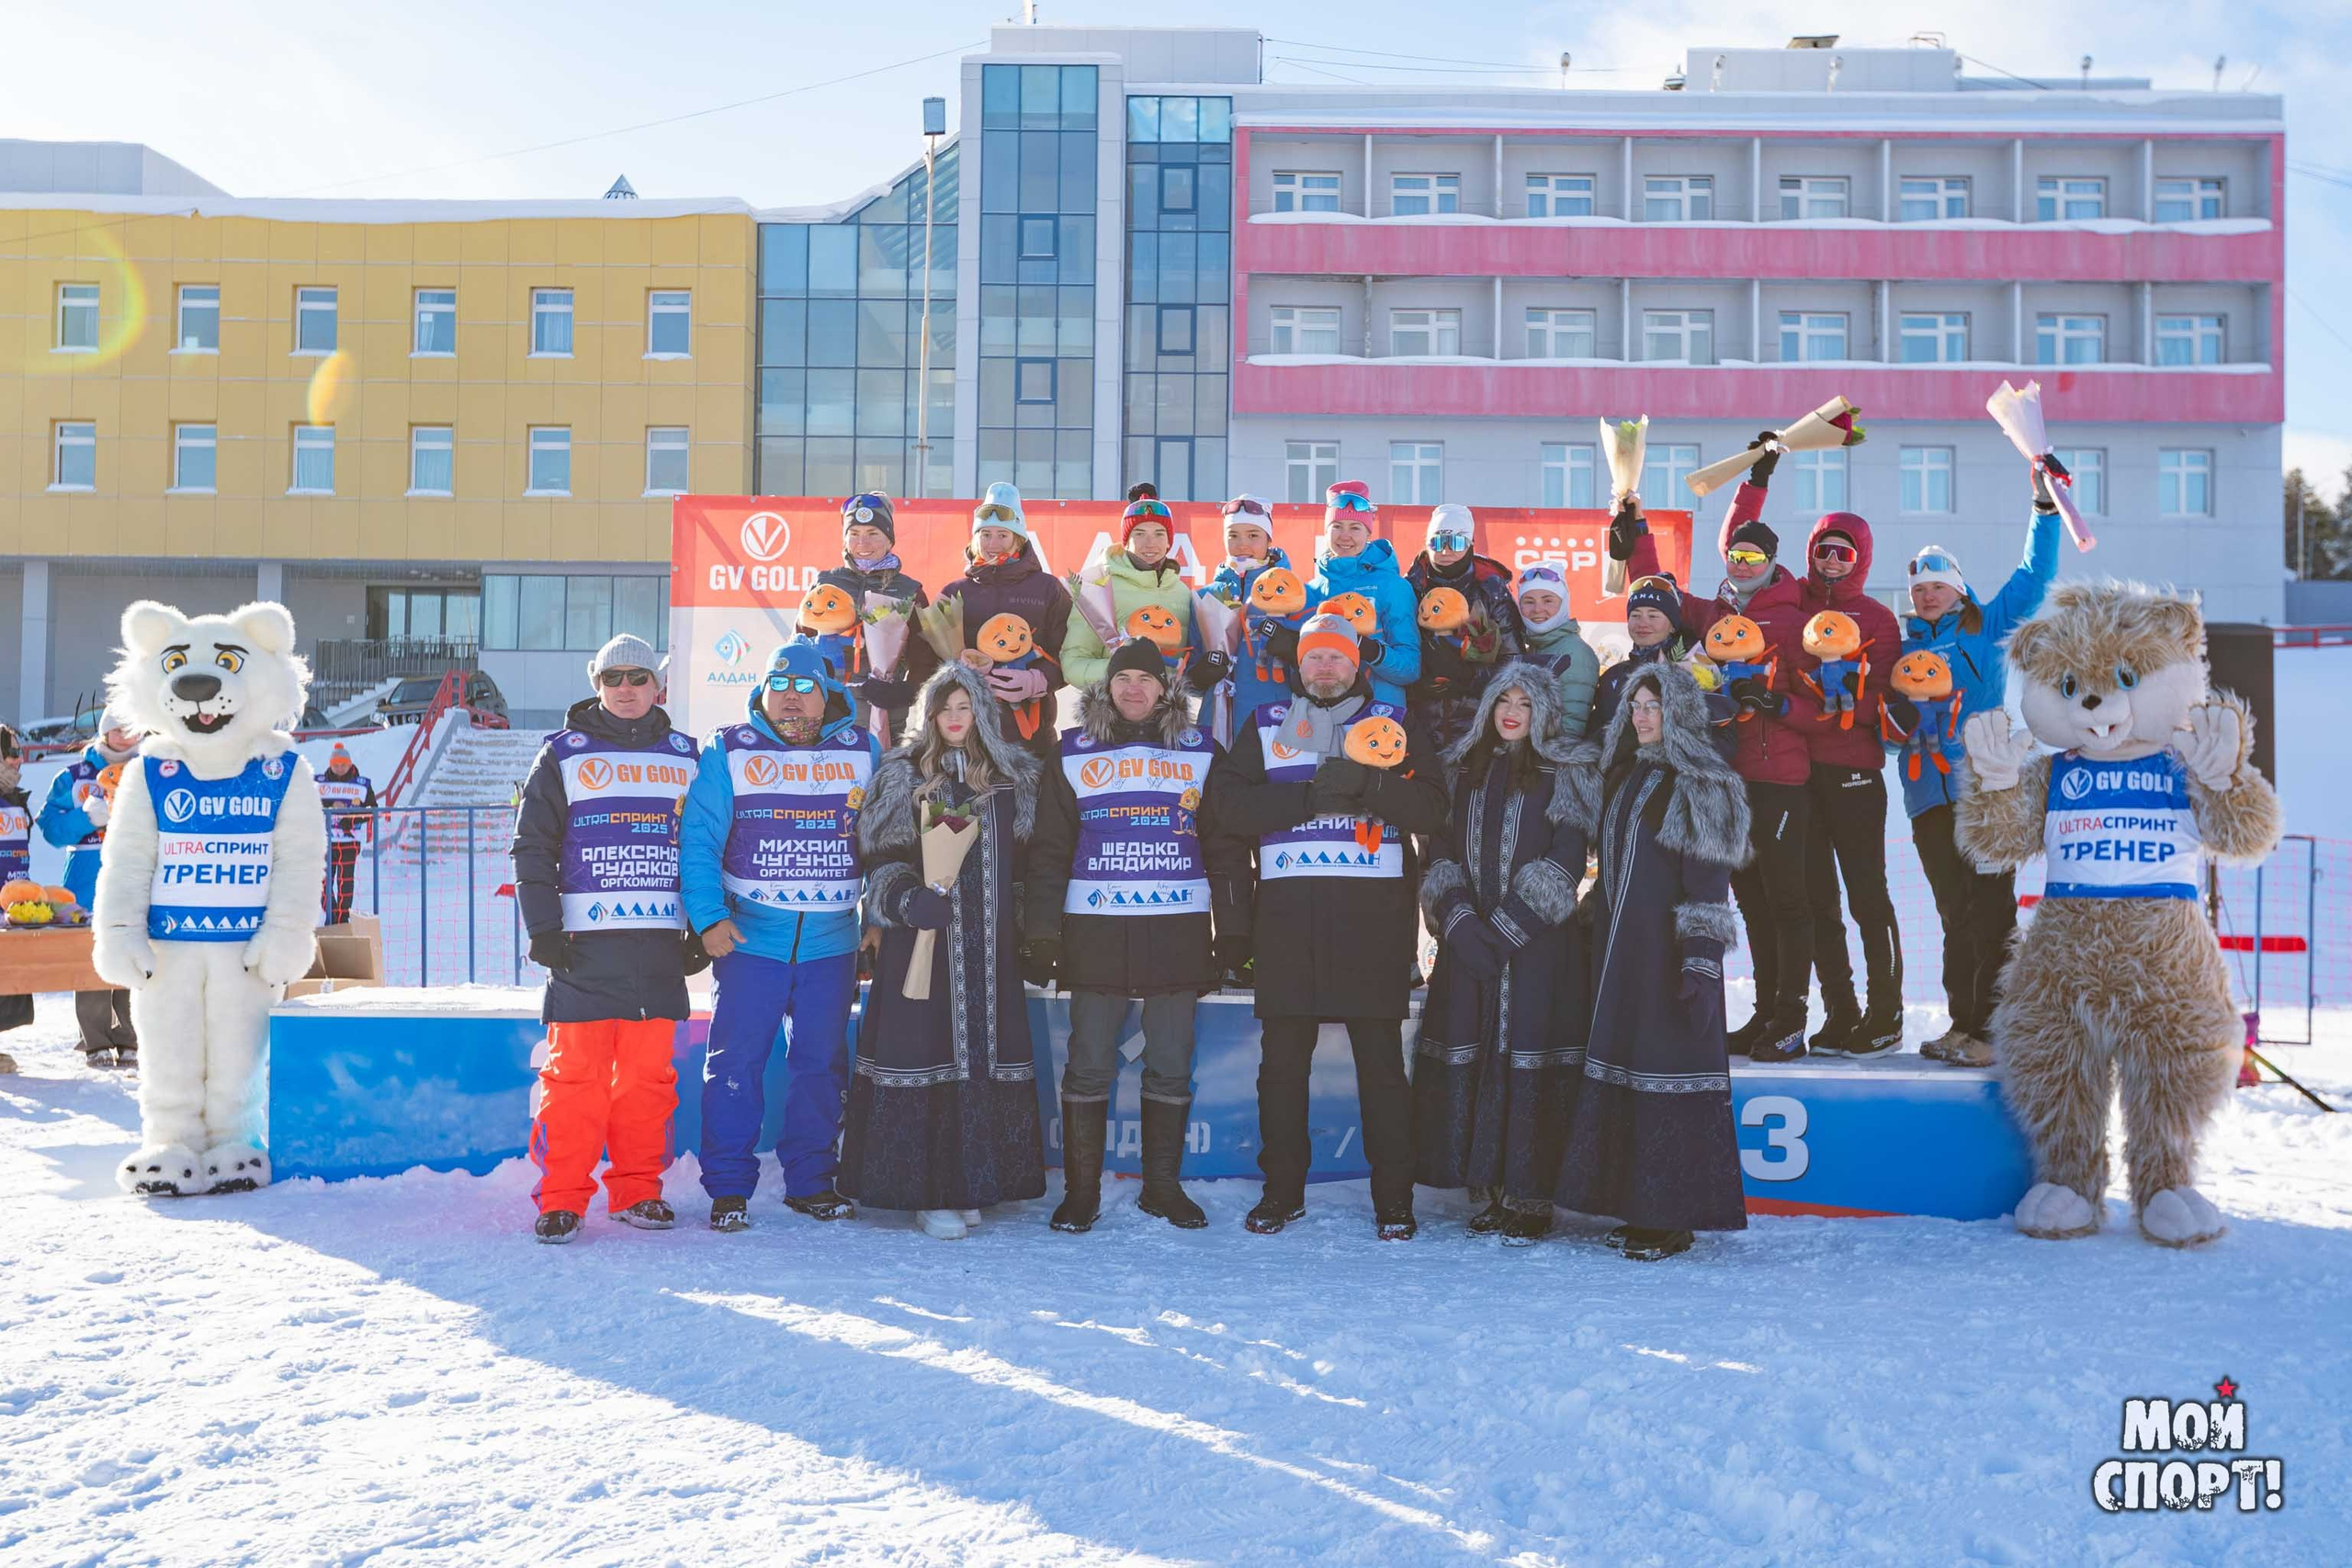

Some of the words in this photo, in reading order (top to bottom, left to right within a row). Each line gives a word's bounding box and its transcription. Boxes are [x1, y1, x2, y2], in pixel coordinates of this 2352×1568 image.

[708, 564, 745, 591] GV
[751, 565, 819, 592] GOLD
[707, 672, 756, 683] АЛДАН
[617, 764, 641, 783] GV
[647, 764, 687, 786] GOLD
[783, 763, 808, 781] GV
[812, 762, 855, 781] GOLD
[1119, 759, 1143, 778] GV
[1148, 759, 1193, 781] GOLD
[2096, 771, 2123, 791] GV
[199, 796, 225, 816] GV
[229, 796, 271, 817] GOLD
[631, 823, 668, 834] 2025
[795, 819, 836, 829] 2025
[1130, 816, 1170, 826] 2025
[2059, 817, 2177, 835] ULTRAСПРИНТ
[164, 840, 269, 855] ULTRAСПРИНТ
[759, 839, 848, 852] МИХАИЛ
[1102, 841, 1180, 857] ШЕДЬКО
[2060, 840, 2176, 863] ТРЕНЕР
[582, 845, 680, 863] АЛЕКСАНД
[752, 853, 854, 866] ЧУГУНОВ
[592, 861, 678, 877] РУДАКОВ
[1088, 856, 1192, 872] ВЛАДИМИР
[163, 864, 269, 885] ТРЕНЕР
[759, 868, 848, 877] ОРГКОМИТЕТ
[600, 877, 674, 888] ОРГКОМИТЕТ
[1740, 1096, 1809, 1181] 3
